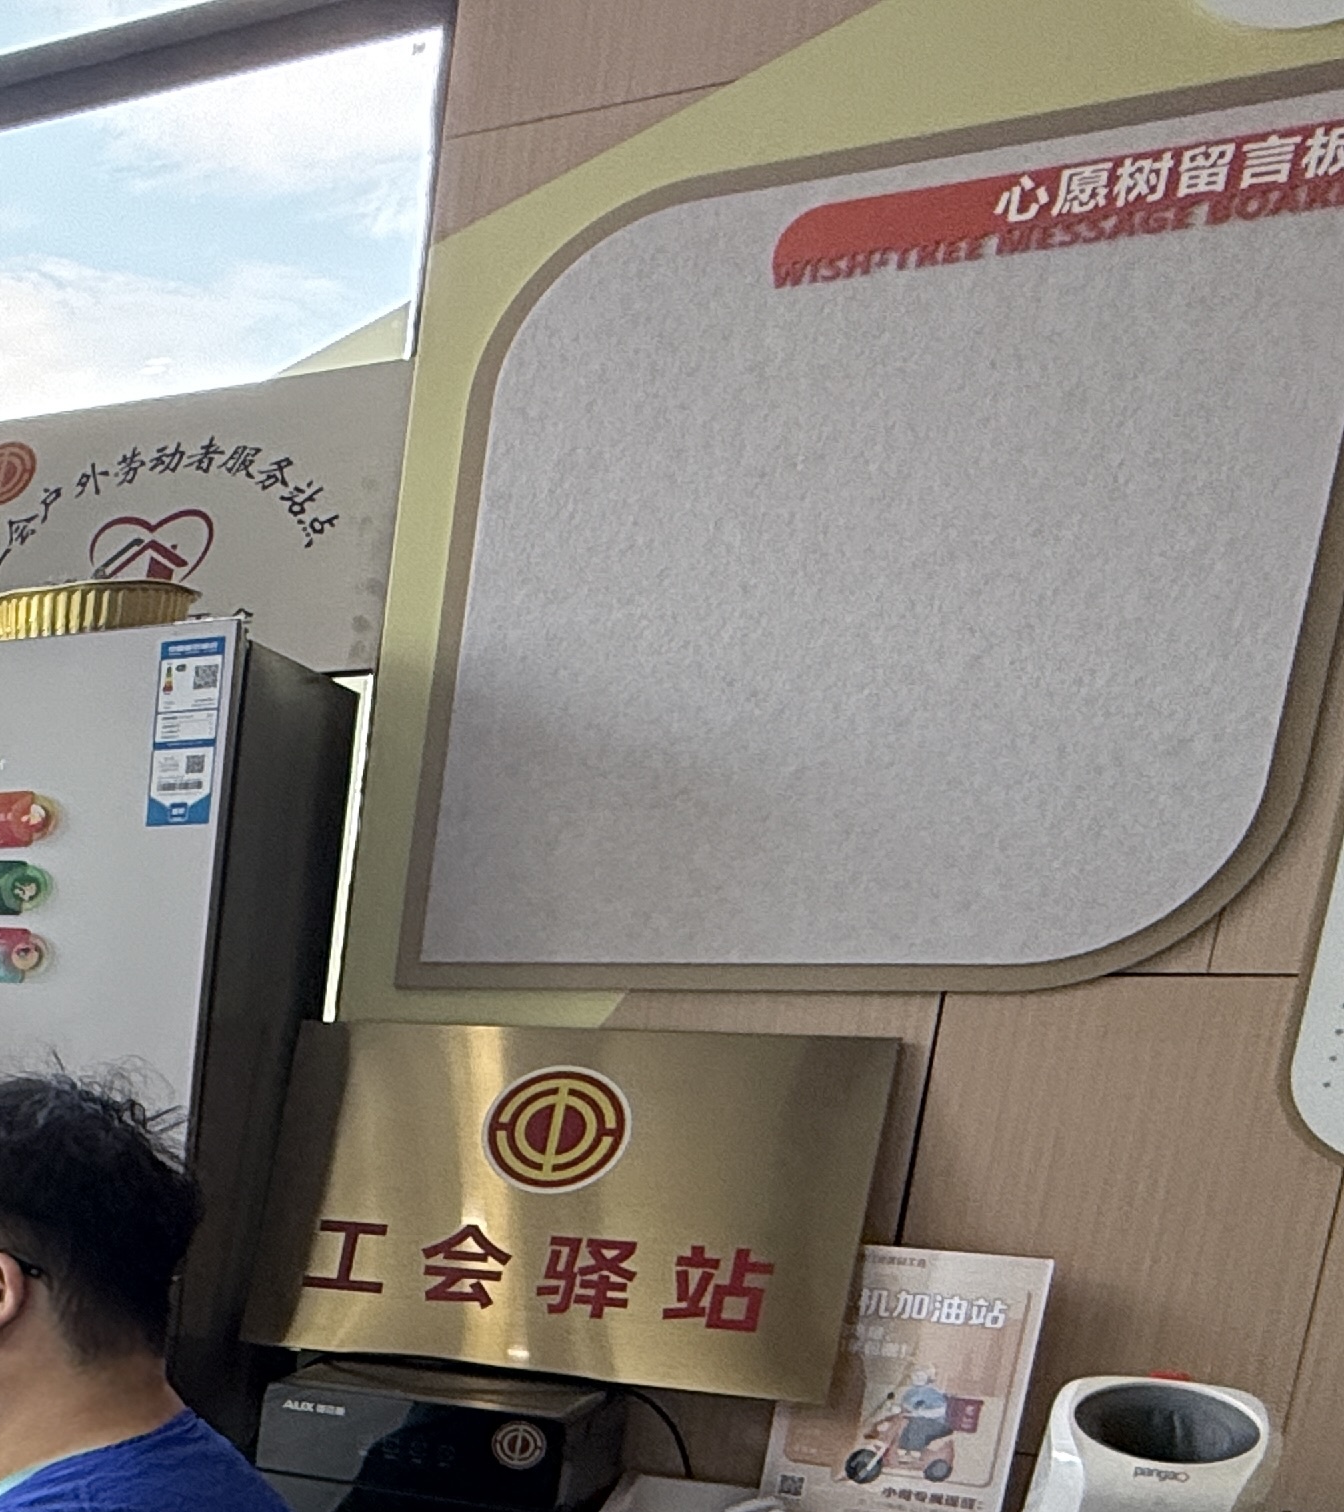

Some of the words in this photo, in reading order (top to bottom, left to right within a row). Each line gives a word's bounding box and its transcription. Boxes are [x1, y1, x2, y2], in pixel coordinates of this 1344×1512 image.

[993, 125, 1344, 224] 心愿树留言板
[302, 1218, 776, 1334] 工会驿站
